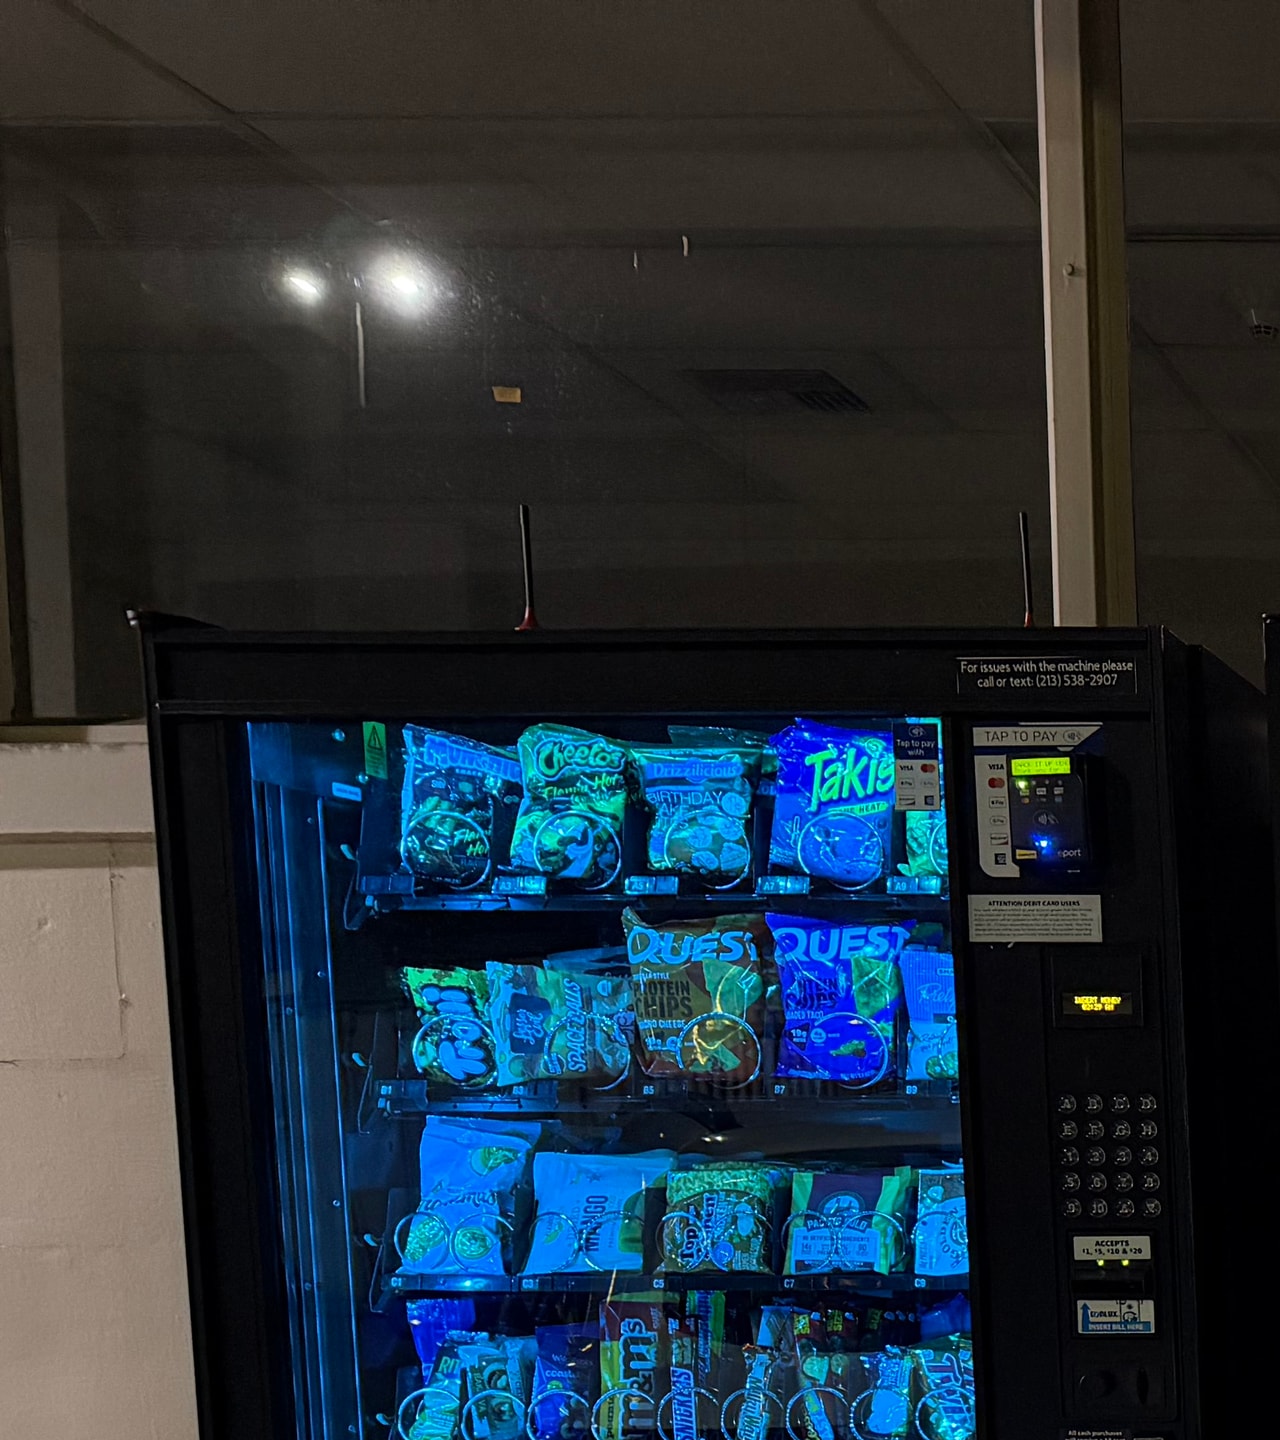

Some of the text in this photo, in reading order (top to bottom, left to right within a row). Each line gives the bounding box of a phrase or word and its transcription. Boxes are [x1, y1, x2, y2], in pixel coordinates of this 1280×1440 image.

[961, 661, 1133, 674] For issues with the machine please
[978, 674, 1117, 688] call or text: (213) 538-2907
[984, 730, 1057, 742] TAP TO PAY
[537, 739, 624, 779] Cheetos
[652, 762, 739, 780] Drizzilicious
[806, 748, 895, 812] Takis
[647, 792, 723, 805] BIRTHDAY
[780, 926, 911, 962] QUEST
[563, 978, 582, 1016] BALLS
[634, 997, 693, 1019] CHIPS
